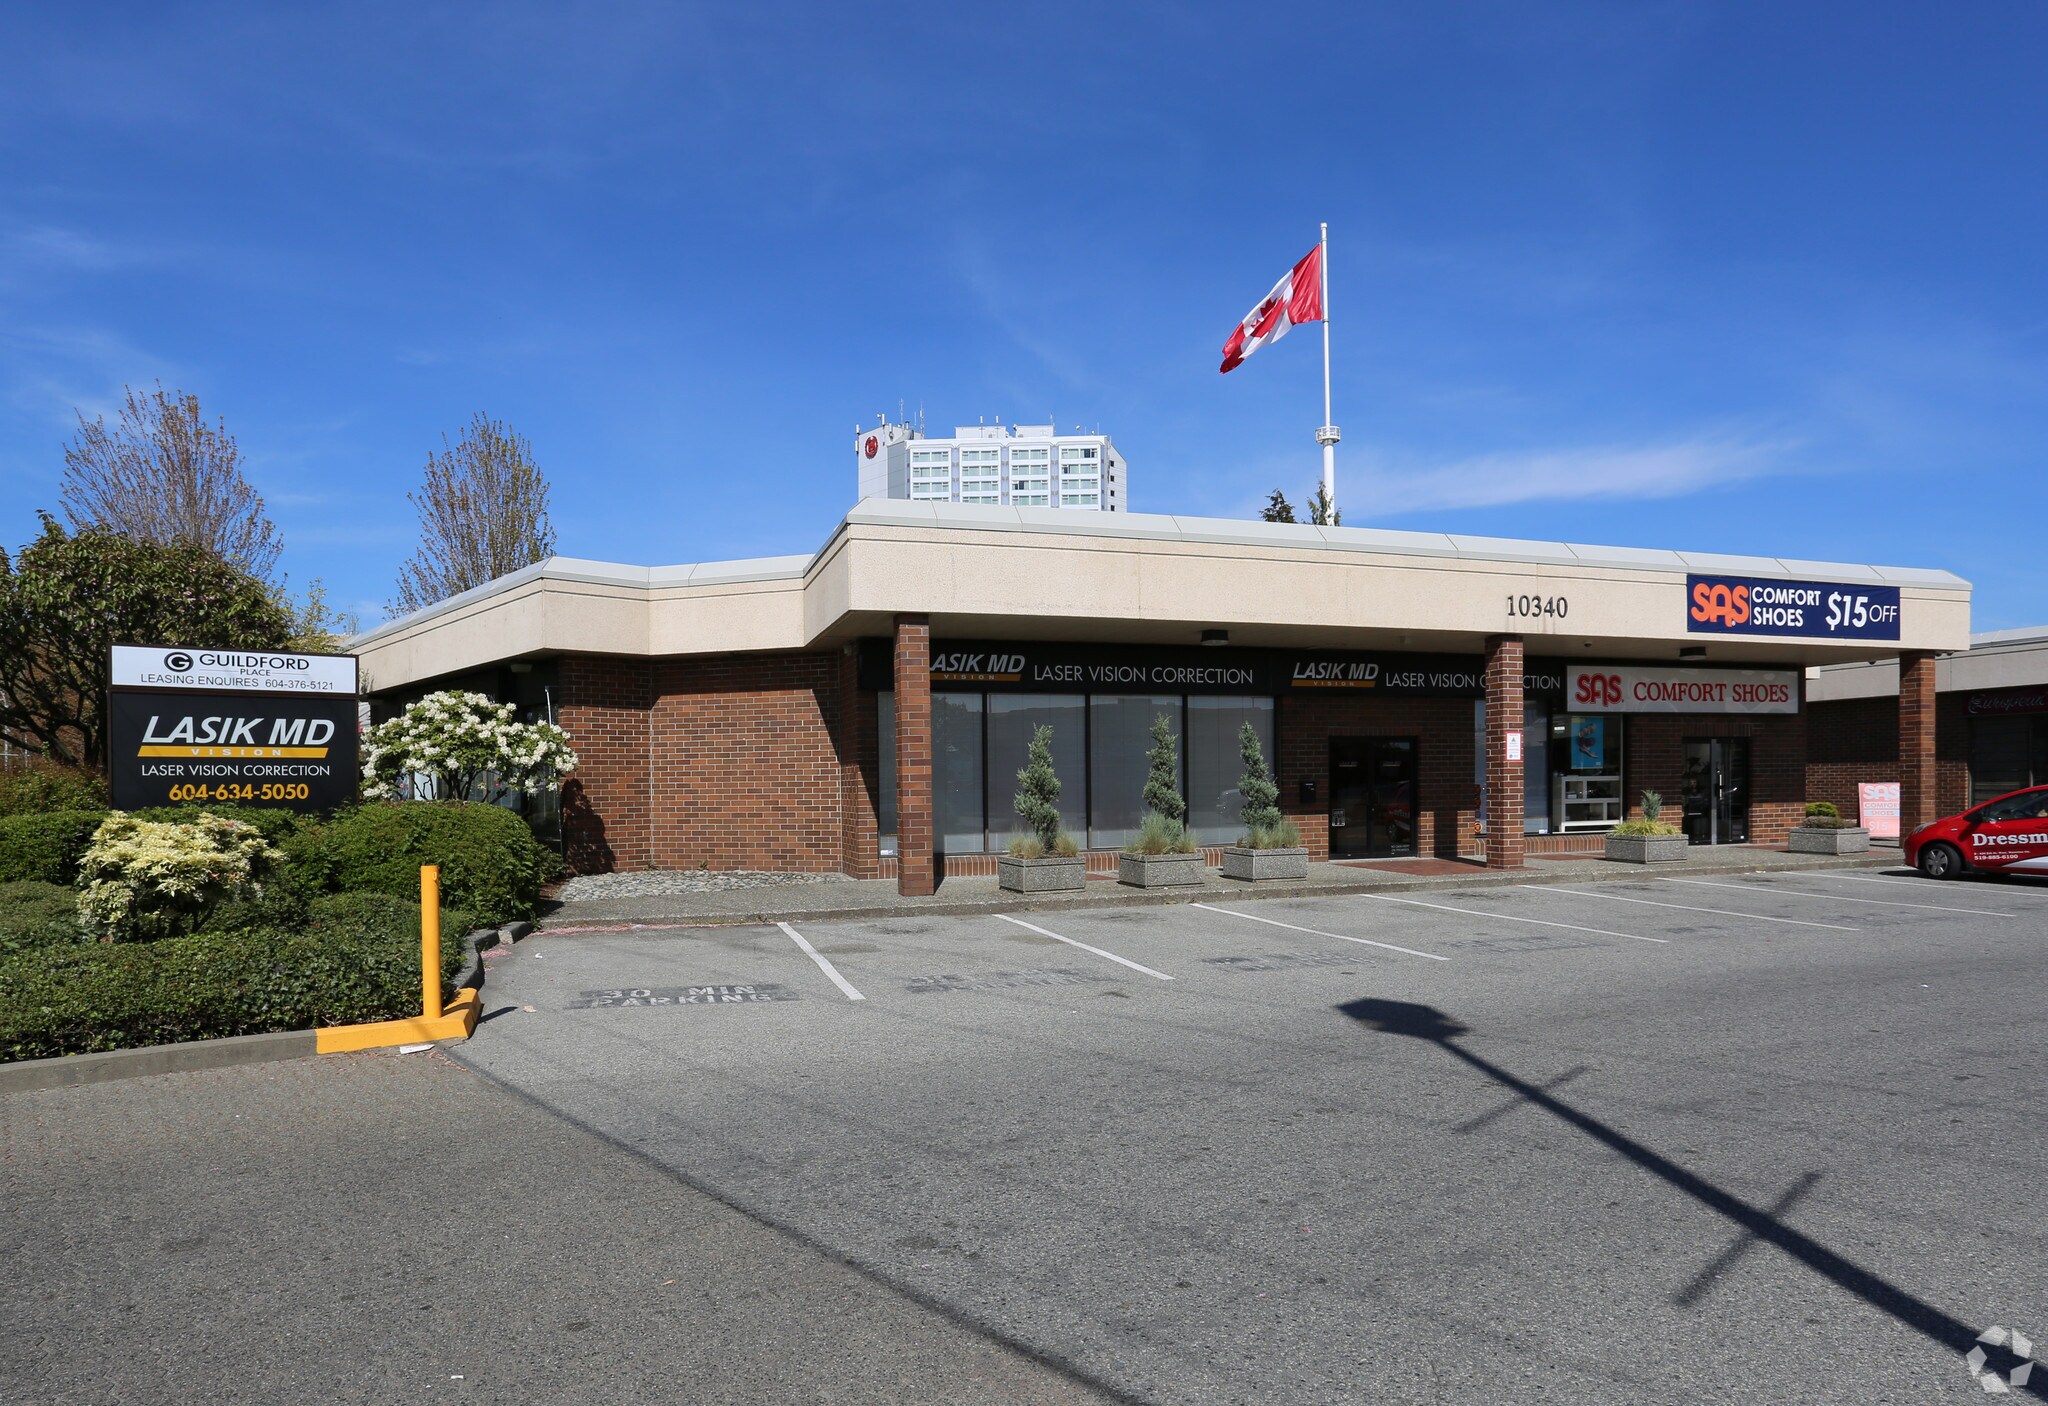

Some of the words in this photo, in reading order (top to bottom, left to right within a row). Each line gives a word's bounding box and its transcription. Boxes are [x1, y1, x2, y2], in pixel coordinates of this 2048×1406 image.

[1752, 586, 1821, 605] COMFORT
[1507, 595, 1568, 618] 10340
[1691, 583, 1749, 627] SAS
[1825, 591, 1868, 631] $15
[1869, 604, 1898, 623] OFF
[1753, 606, 1804, 628] SHOES
[199, 653, 310, 670] GUILDFORD
[930, 653, 985, 672] ASIK
[987, 654, 1026, 673] MD
[240, 668, 271, 676] PLACE
[1034, 664, 1083, 681] LASER
[1089, 666, 1146, 683] VISION
[1151, 667, 1253, 684] CORRECTION
[1293, 662, 1349, 679] LASIK
[1348, 663, 1379, 680] MD
[140, 673, 194, 685] LEASING
[198, 675, 259, 687] ENQUIRES
[265, 678, 333, 690] 604-376-5121
[1386, 672, 1425, 688] LASER
[1430, 673, 1476, 688] VISION
[1479, 674, 1561, 690] CCTION
[1575, 673, 1622, 707] SAS
[1633, 681, 1727, 702] COMFORT
[1732, 683, 1789, 703] SHOES
[142, 715, 265, 744] LASIK
[268, 718, 335, 745] MD
[191, 748, 283, 756] VISION
[141, 764, 185, 776] LASER
[189, 764, 239, 776] VISION
[243, 765, 330, 776] CORRECTION
[169, 783, 309, 801] 604-634-5050
[1863, 785, 1900, 800] SAS
[590, 994, 772, 1008] PARKING
[602, 989, 651, 998] 30
[688, 986, 756, 995] MIN
